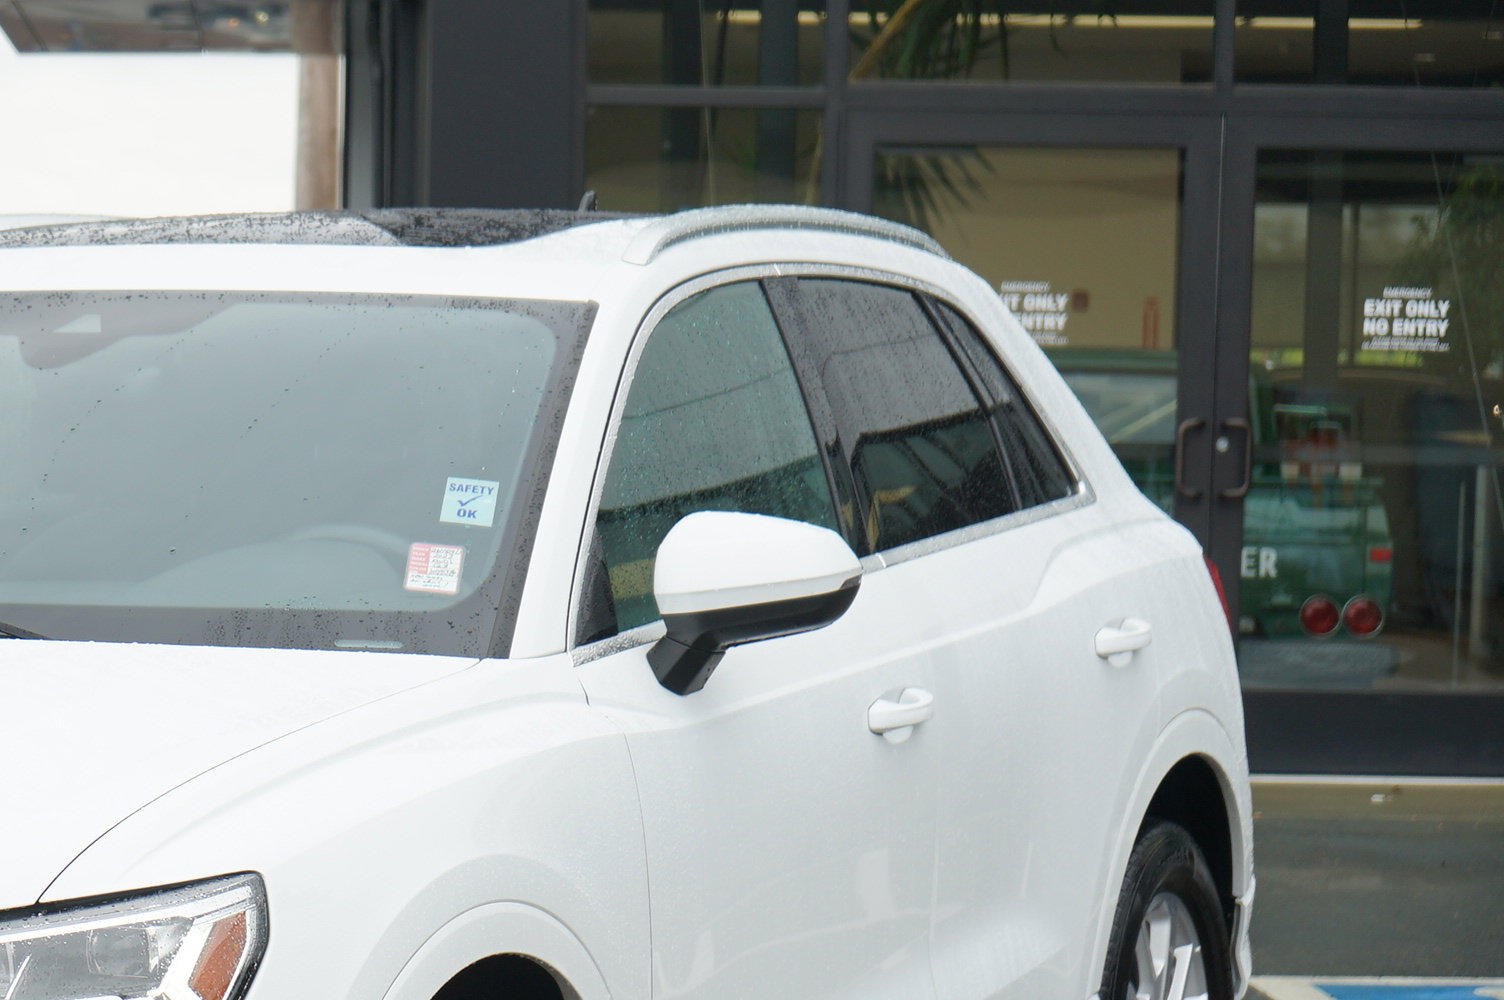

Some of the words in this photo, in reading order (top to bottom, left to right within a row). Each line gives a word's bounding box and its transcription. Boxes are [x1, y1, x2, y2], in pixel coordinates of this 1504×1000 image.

[1023, 293, 1068, 312] ONLY
[1363, 298, 1402, 317] EXIT
[1406, 299, 1450, 318] ONLY
[1363, 317, 1388, 336] NO
[1392, 318, 1450, 337] ENTRY
[448, 482, 495, 496] SAFETY
[457, 508, 478, 519] OK
